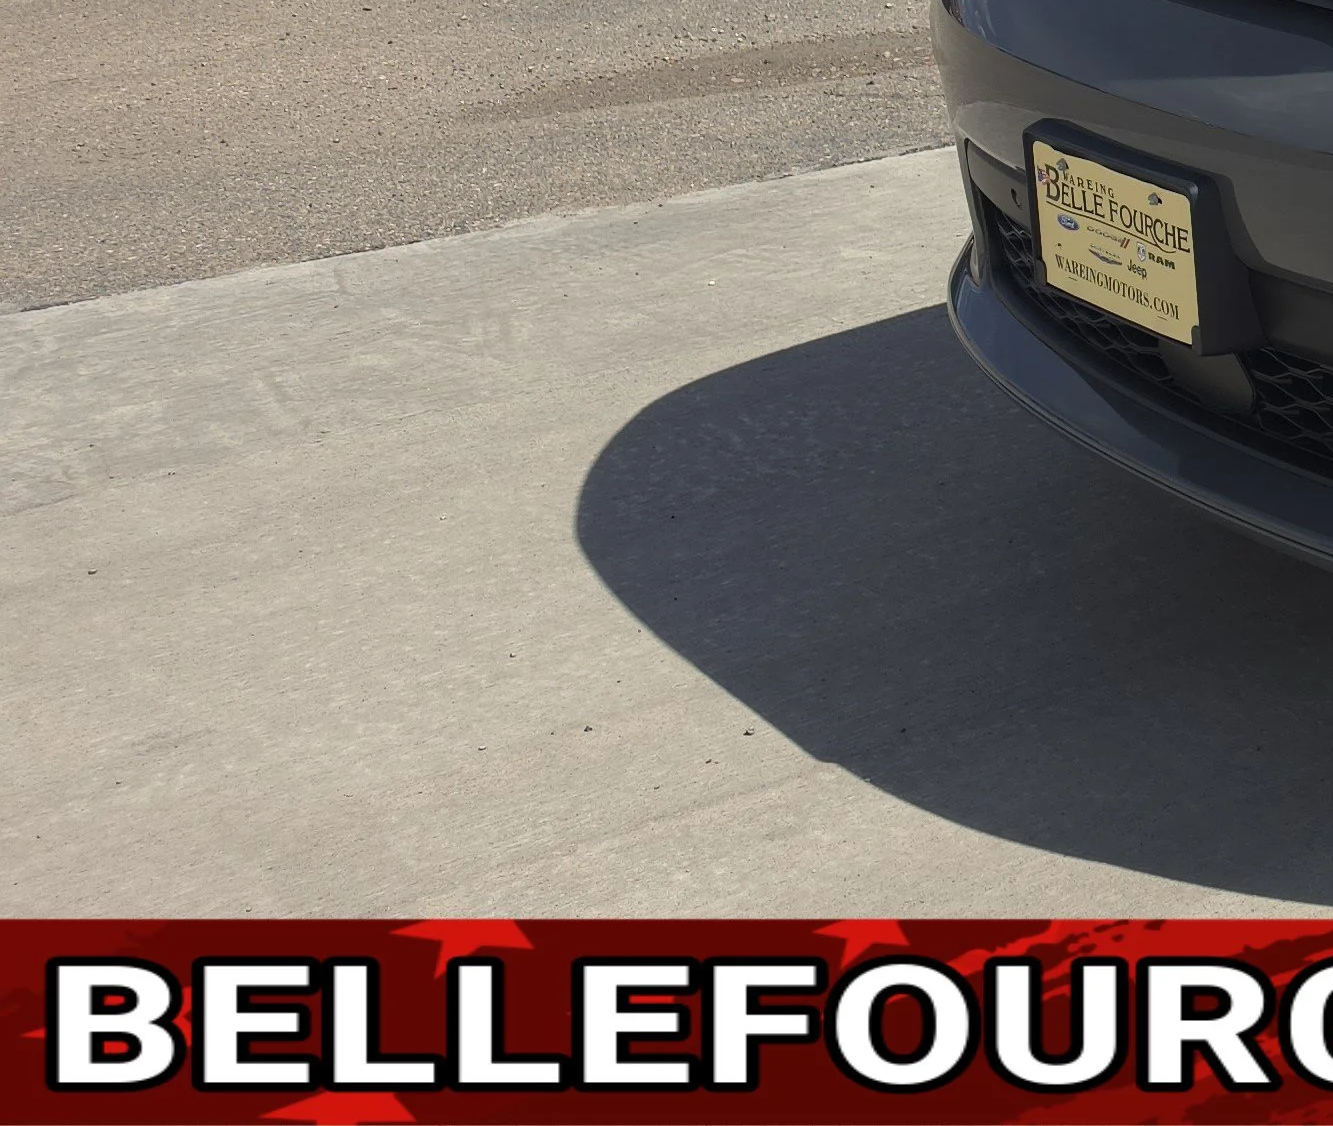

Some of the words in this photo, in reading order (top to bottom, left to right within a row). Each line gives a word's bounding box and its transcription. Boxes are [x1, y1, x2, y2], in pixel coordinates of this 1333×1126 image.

[1062, 171, 1115, 199] WAREING
[1044, 161, 1106, 219] BELLE
[1108, 200, 1191, 254] FOURCHE
[1127, 259, 1148, 280] Jeep
[1148, 251, 1176, 271] RAM
[1055, 253, 1180, 321] WAREINGMOTORS.COM
